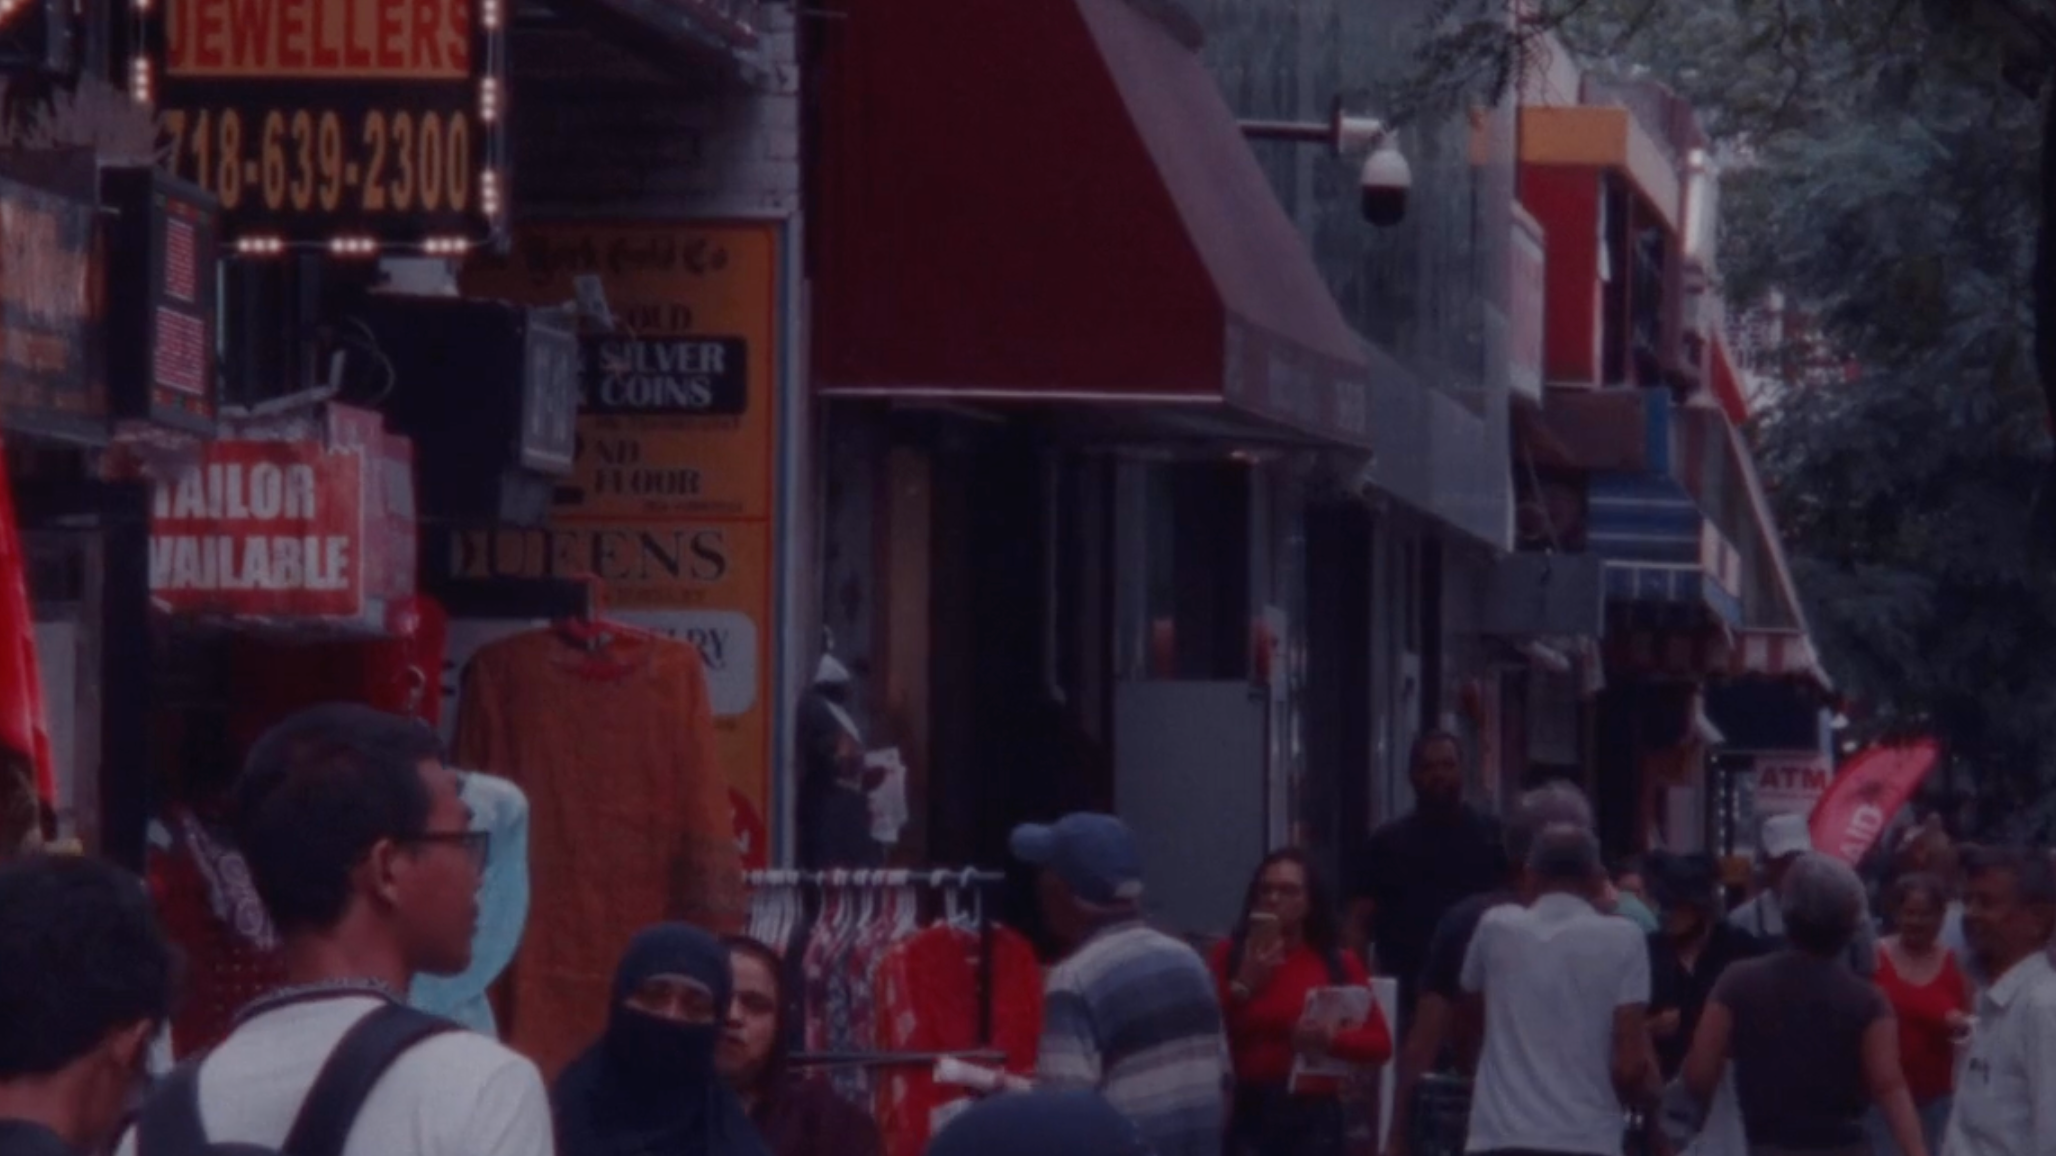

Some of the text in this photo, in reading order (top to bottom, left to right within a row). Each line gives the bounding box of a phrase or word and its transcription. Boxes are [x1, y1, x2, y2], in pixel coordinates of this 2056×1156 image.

[164, 0, 469, 71] JEWELLERS
[163, 107, 469, 211] 718-639-2300
[628, 303, 692, 331] OLD
[599, 341, 725, 375] SILVER
[600, 375, 713, 408] COINS
[149, 534, 350, 590] VAILABLE
[1758, 767, 1828, 790] ATM
